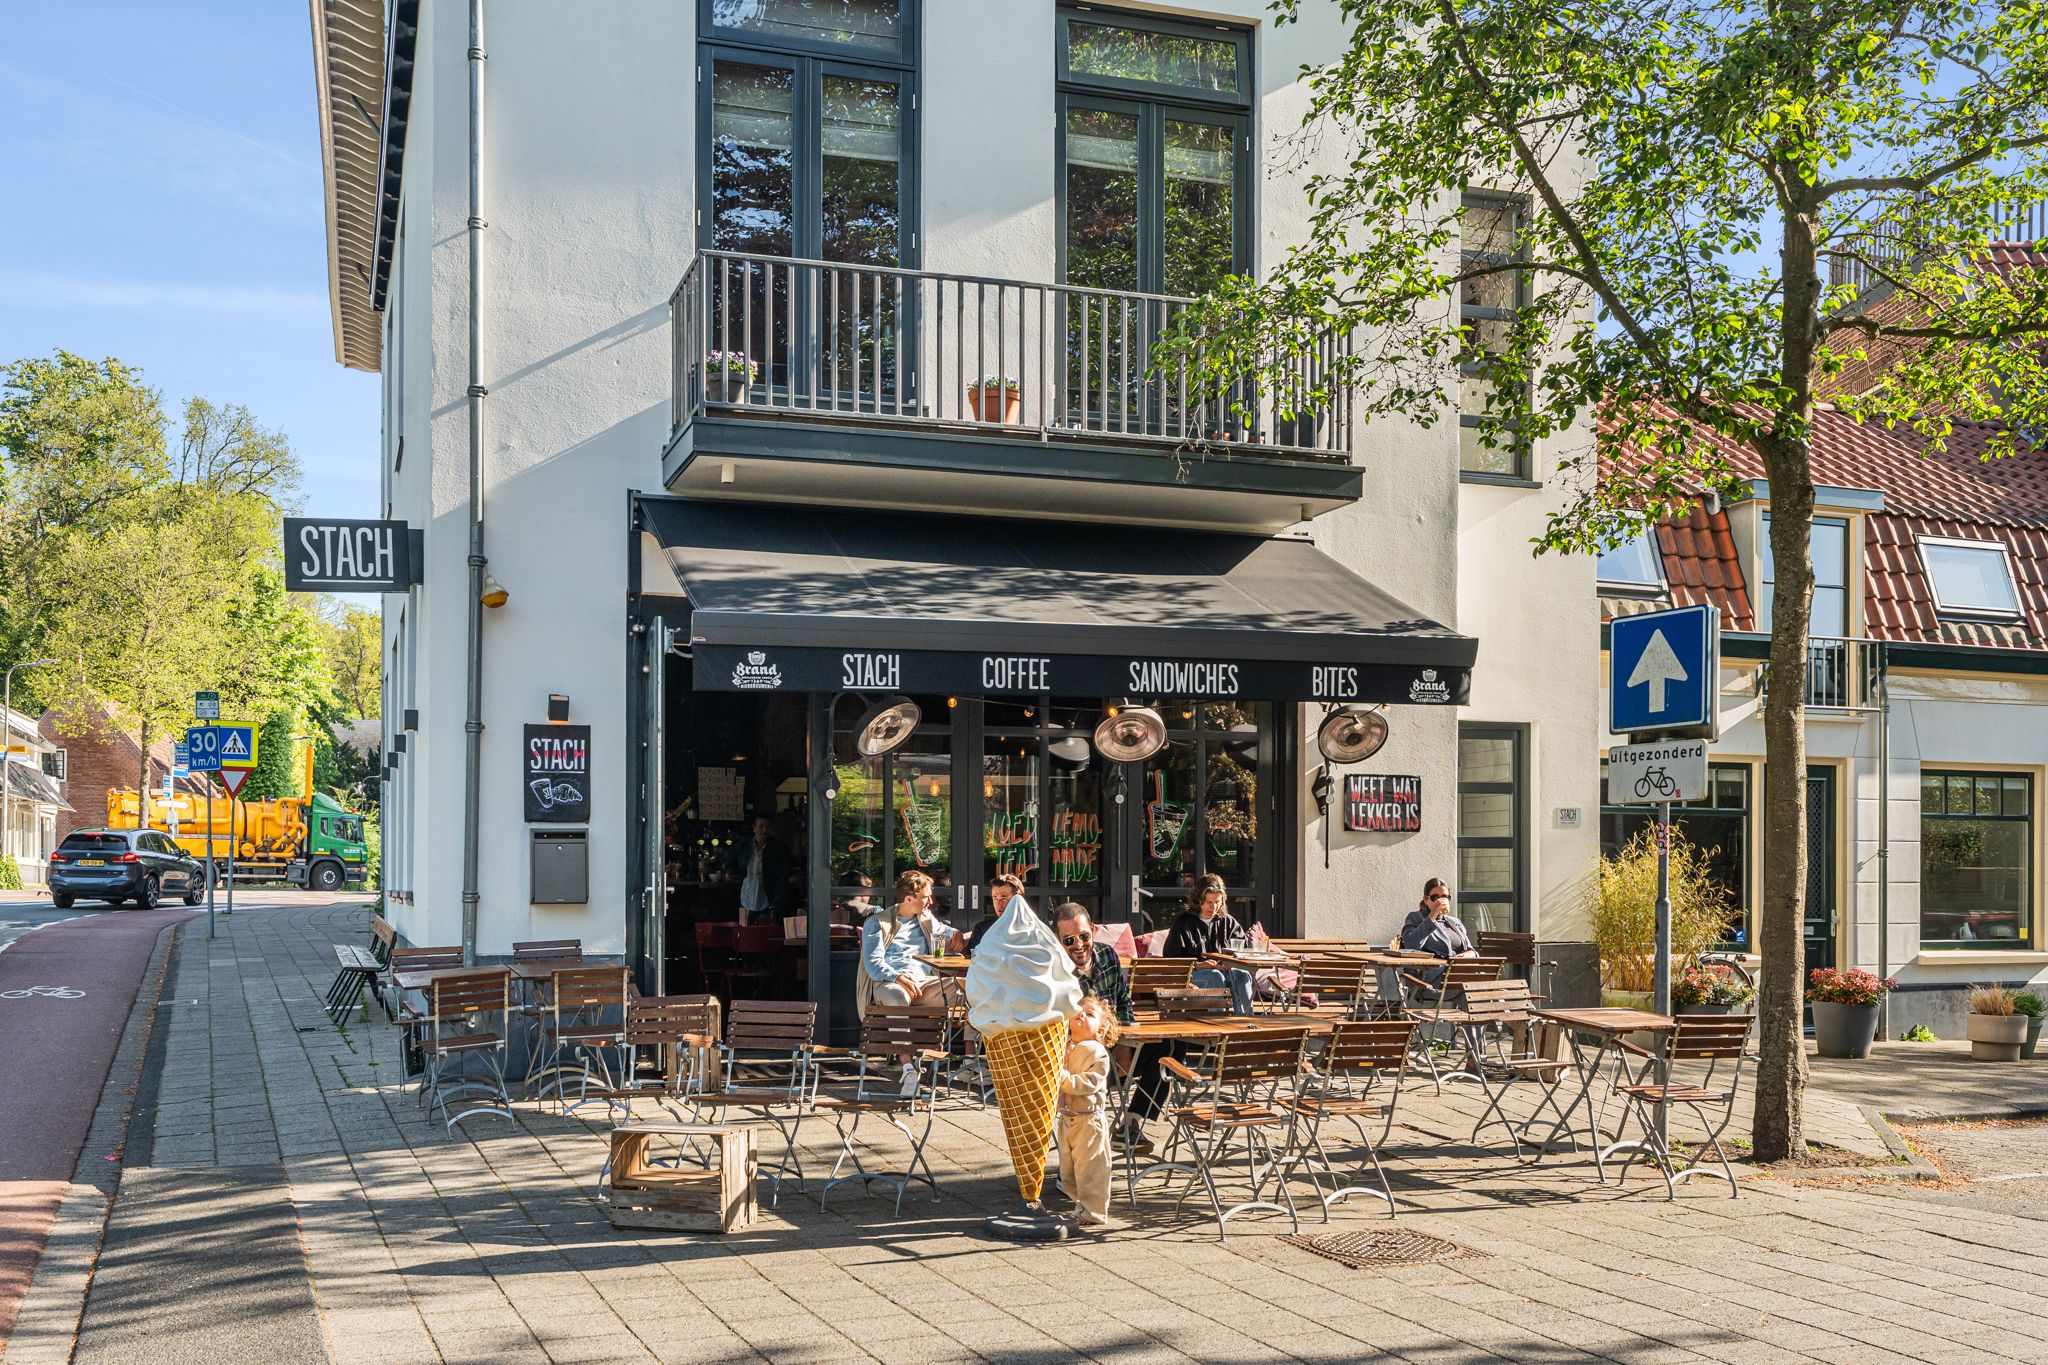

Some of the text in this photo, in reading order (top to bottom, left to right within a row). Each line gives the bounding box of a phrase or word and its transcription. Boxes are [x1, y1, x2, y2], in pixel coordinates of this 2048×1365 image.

[300, 525, 394, 578] STACH
[736, 661, 778, 676] Brand
[842, 653, 900, 687] STACH
[982, 657, 1051, 690] COFFEE
[1128, 661, 1239, 695] SANDWICHES
[1312, 666, 1358, 697] BITES
[1412, 678, 1446, 691] Brand
[191, 731, 217, 753] 30
[529, 737, 586, 770] STACH
[1610, 744, 1703, 766] uitgezonderd
[192, 755, 217, 767] km/h
[1350, 775, 1419, 804] WEET WAT
[989, 811, 1038, 844] ICED
[1351, 802, 1419, 831] LEKKER IS
[1559, 808, 1577, 820] STACH
[994, 846, 1037, 882] TEA
